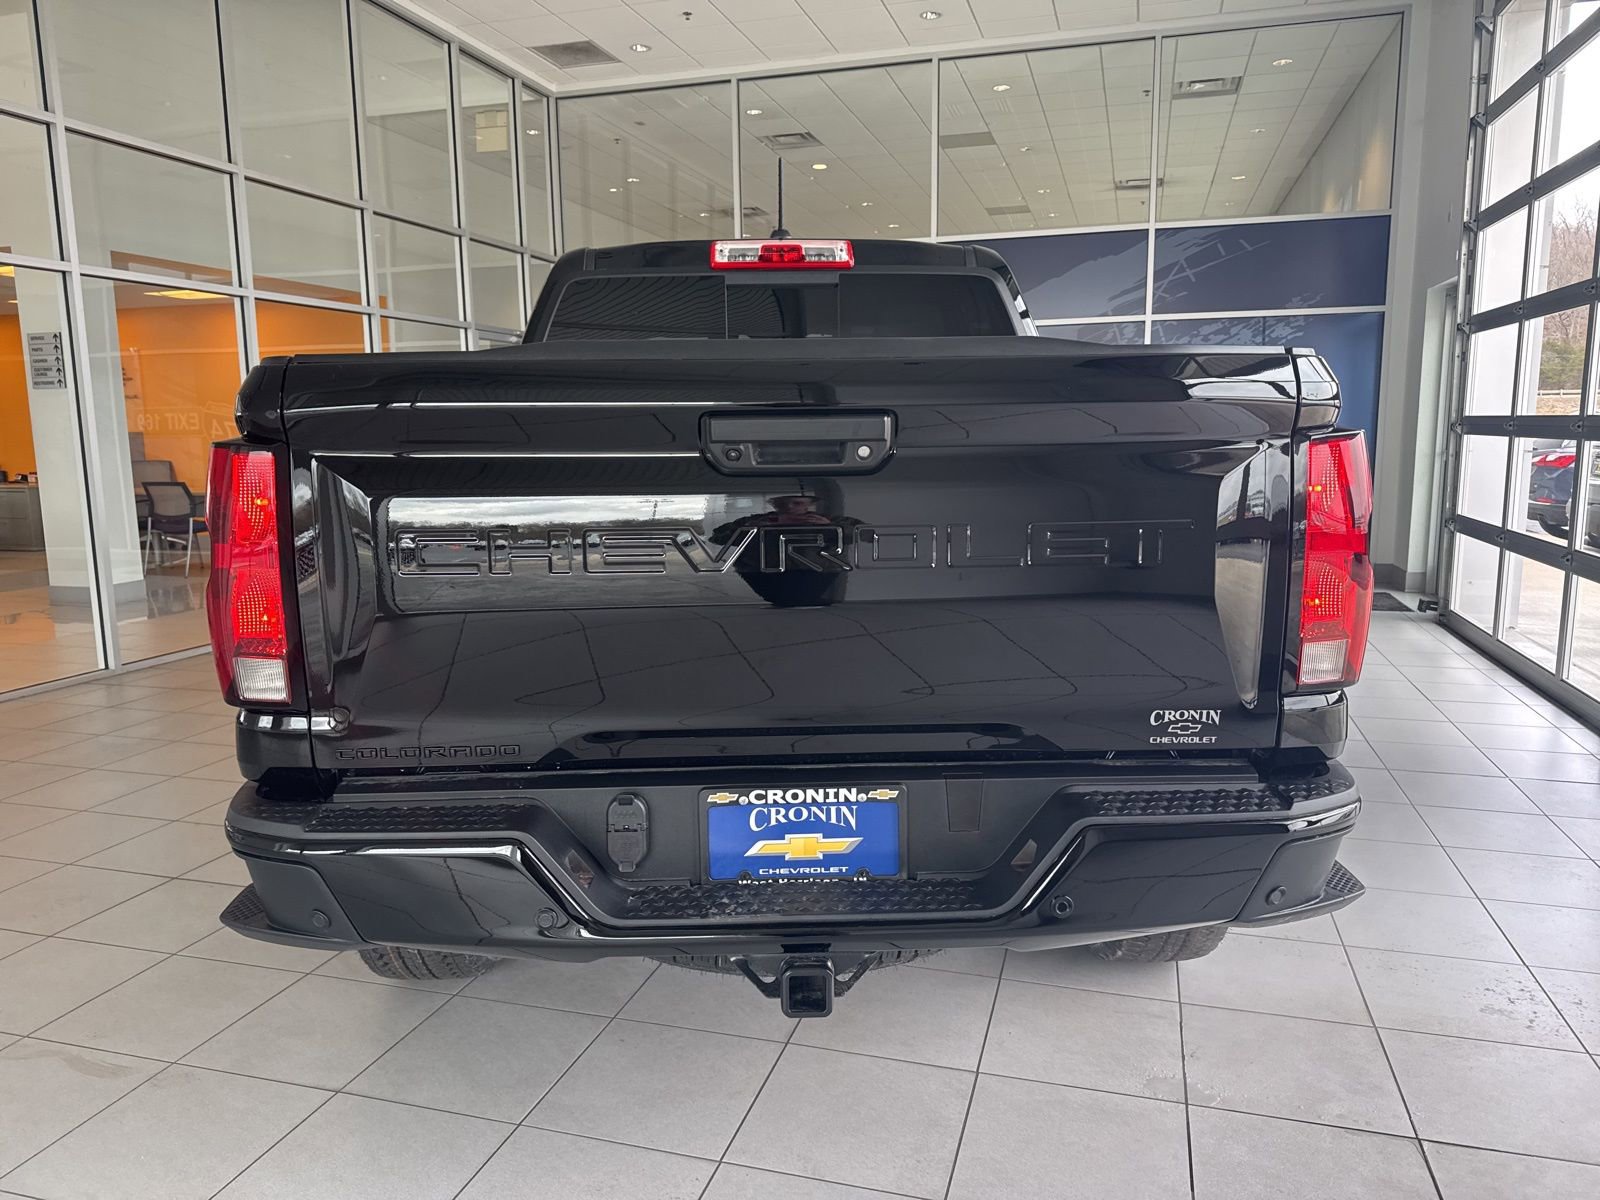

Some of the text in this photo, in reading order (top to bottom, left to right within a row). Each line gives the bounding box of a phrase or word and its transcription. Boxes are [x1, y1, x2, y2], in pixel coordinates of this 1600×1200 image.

[394, 518, 1195, 578] CHEVROLET
[1149, 709, 1222, 726] CRONIN
[1149, 736, 1218, 744] CHEVROLET
[335, 744, 521, 760] COLORADO
[748, 787, 858, 805] CRONIN
[749, 805, 858, 832] CRONIN
[758, 866, 849, 875] CHEVROLET
